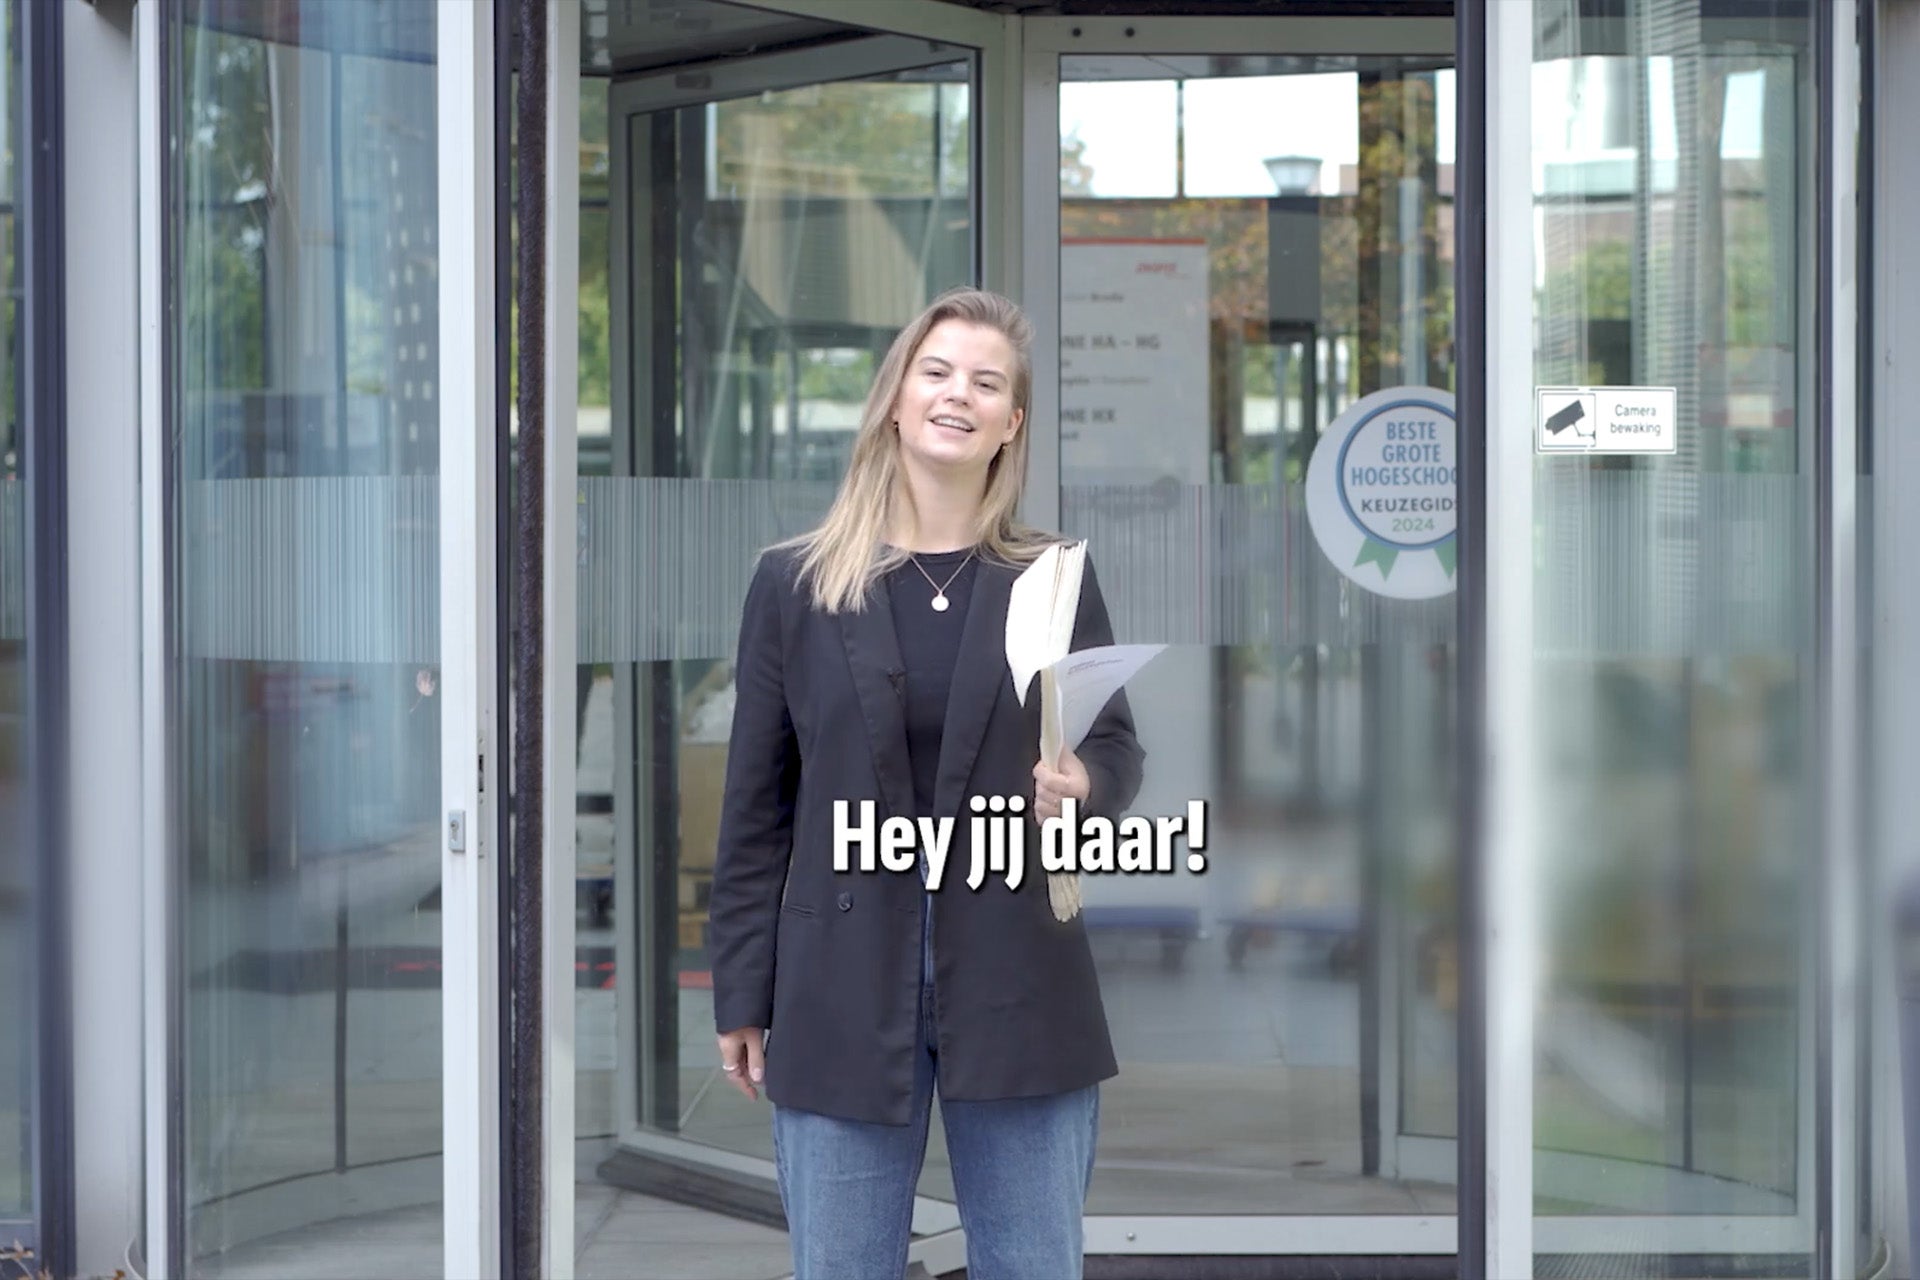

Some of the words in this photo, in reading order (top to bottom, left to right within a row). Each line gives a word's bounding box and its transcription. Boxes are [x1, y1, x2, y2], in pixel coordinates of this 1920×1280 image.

[1615, 404, 1656, 417] Camera
[1386, 422, 1437, 440] BESTE
[1610, 422, 1661, 436] bewaking
[1382, 444, 1441, 462] GROTE
[1361, 498, 1456, 513] KEUZEGID
[1392, 518, 1434, 532] 2024
